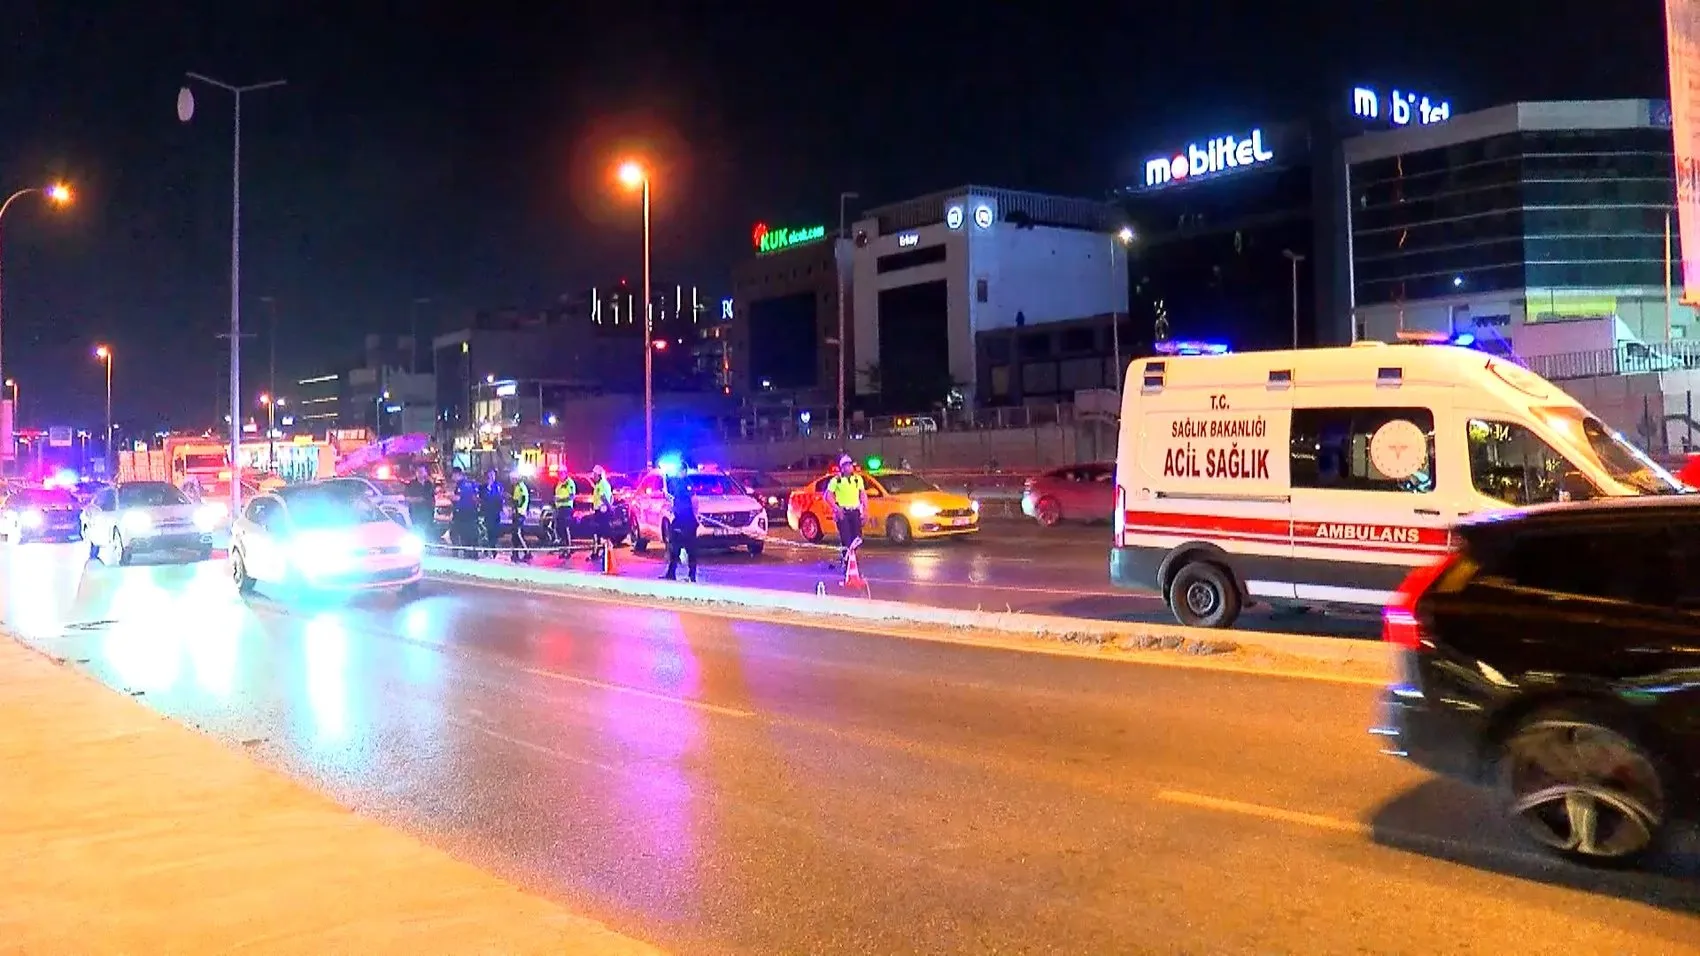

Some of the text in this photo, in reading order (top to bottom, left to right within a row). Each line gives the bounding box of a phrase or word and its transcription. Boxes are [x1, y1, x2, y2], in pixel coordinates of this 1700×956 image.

[1210, 394, 1230, 410] T.C.
[1171, 415, 1266, 438] SAĞLIK BAKANLIĞI
[1206, 442, 1270, 480] SAĞLIK
[1316, 523, 1420, 544] AMBULANS
